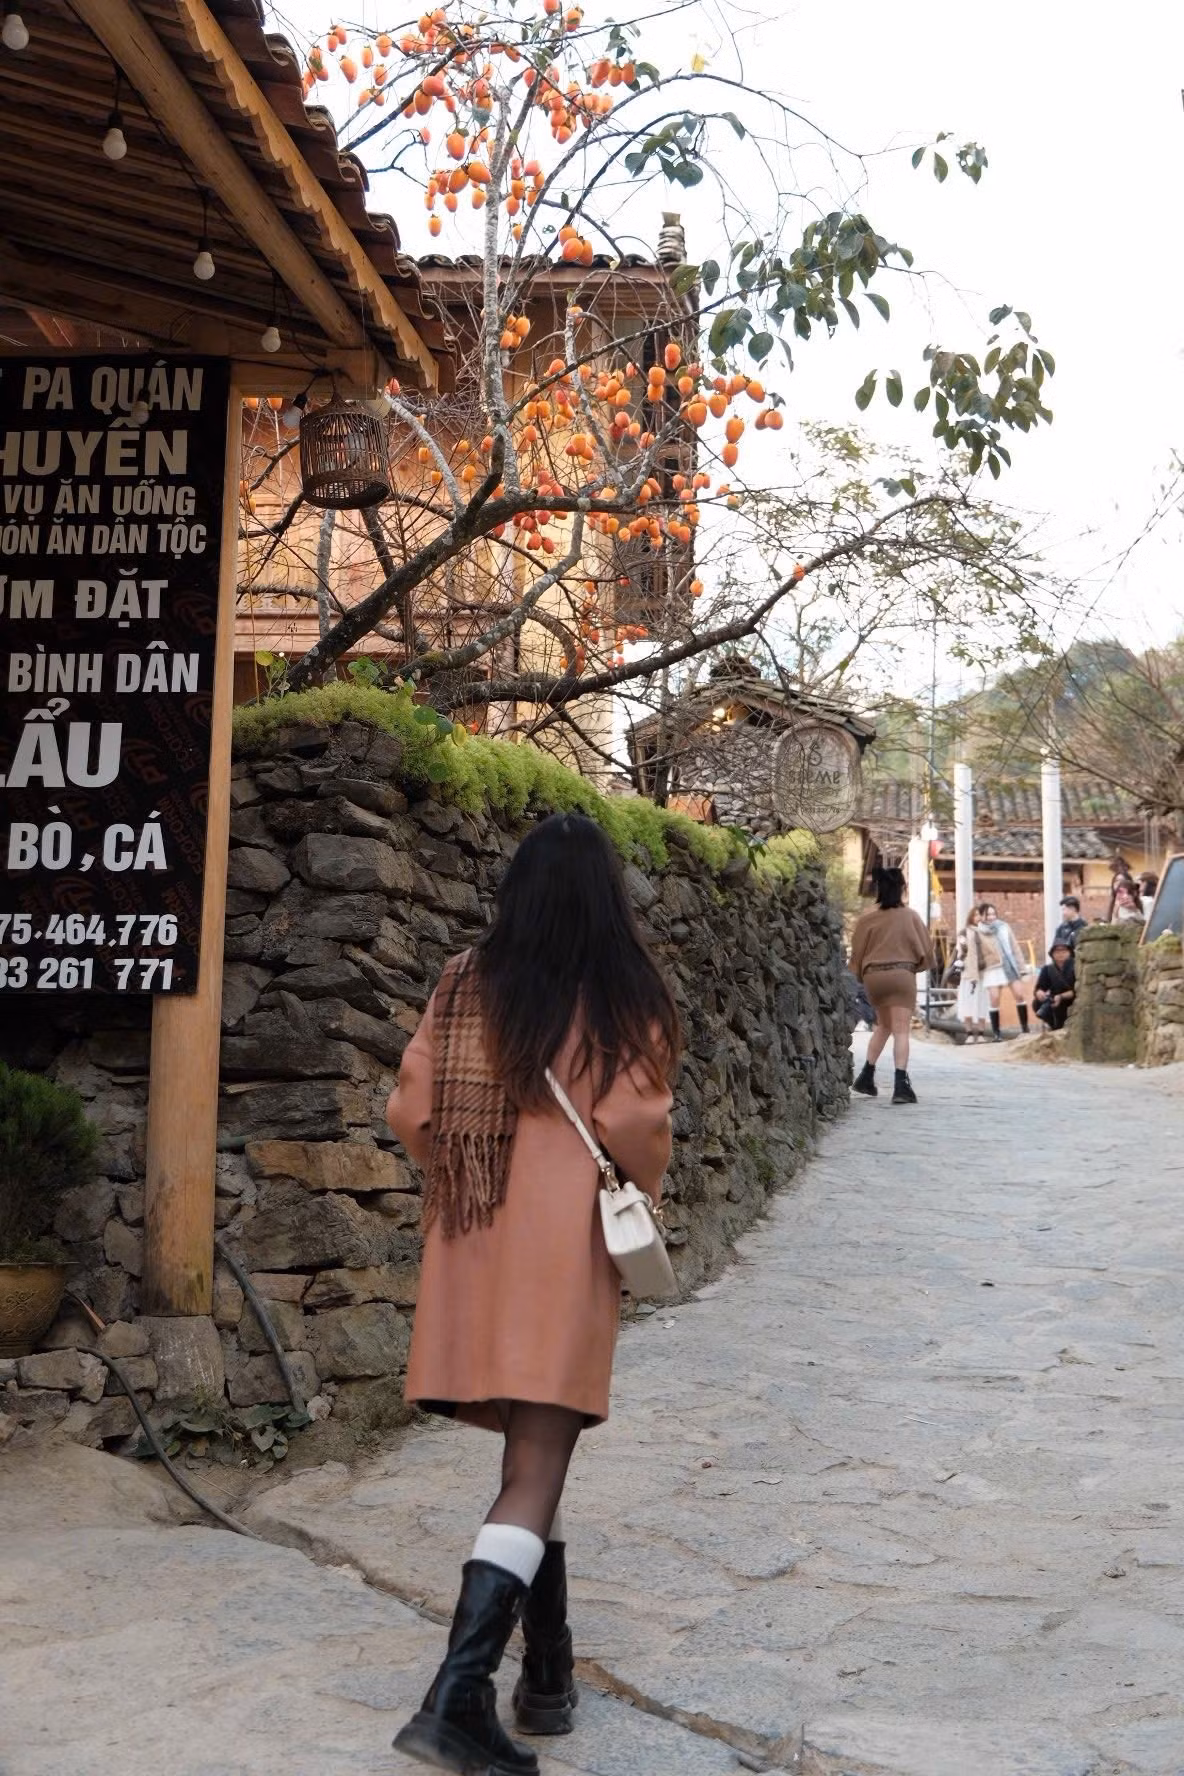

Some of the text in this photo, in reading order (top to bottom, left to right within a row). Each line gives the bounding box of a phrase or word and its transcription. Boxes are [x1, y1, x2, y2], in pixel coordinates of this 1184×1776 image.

[23, 360, 203, 415] PA QUÁN
[5, 479, 195, 522] VỤ ĂN UỐNG
[0, 517, 206, 559] ÓN ĂN DÂN TỘC
[0, 568, 168, 627] M ĐẶT
[9, 641, 199, 692] BÌNH DÂN
[0, 698, 122, 787] ẨU
[103, 811, 167, 871] CÁ
[37, 957, 93, 988] 261
[114, 959, 173, 989] 771
